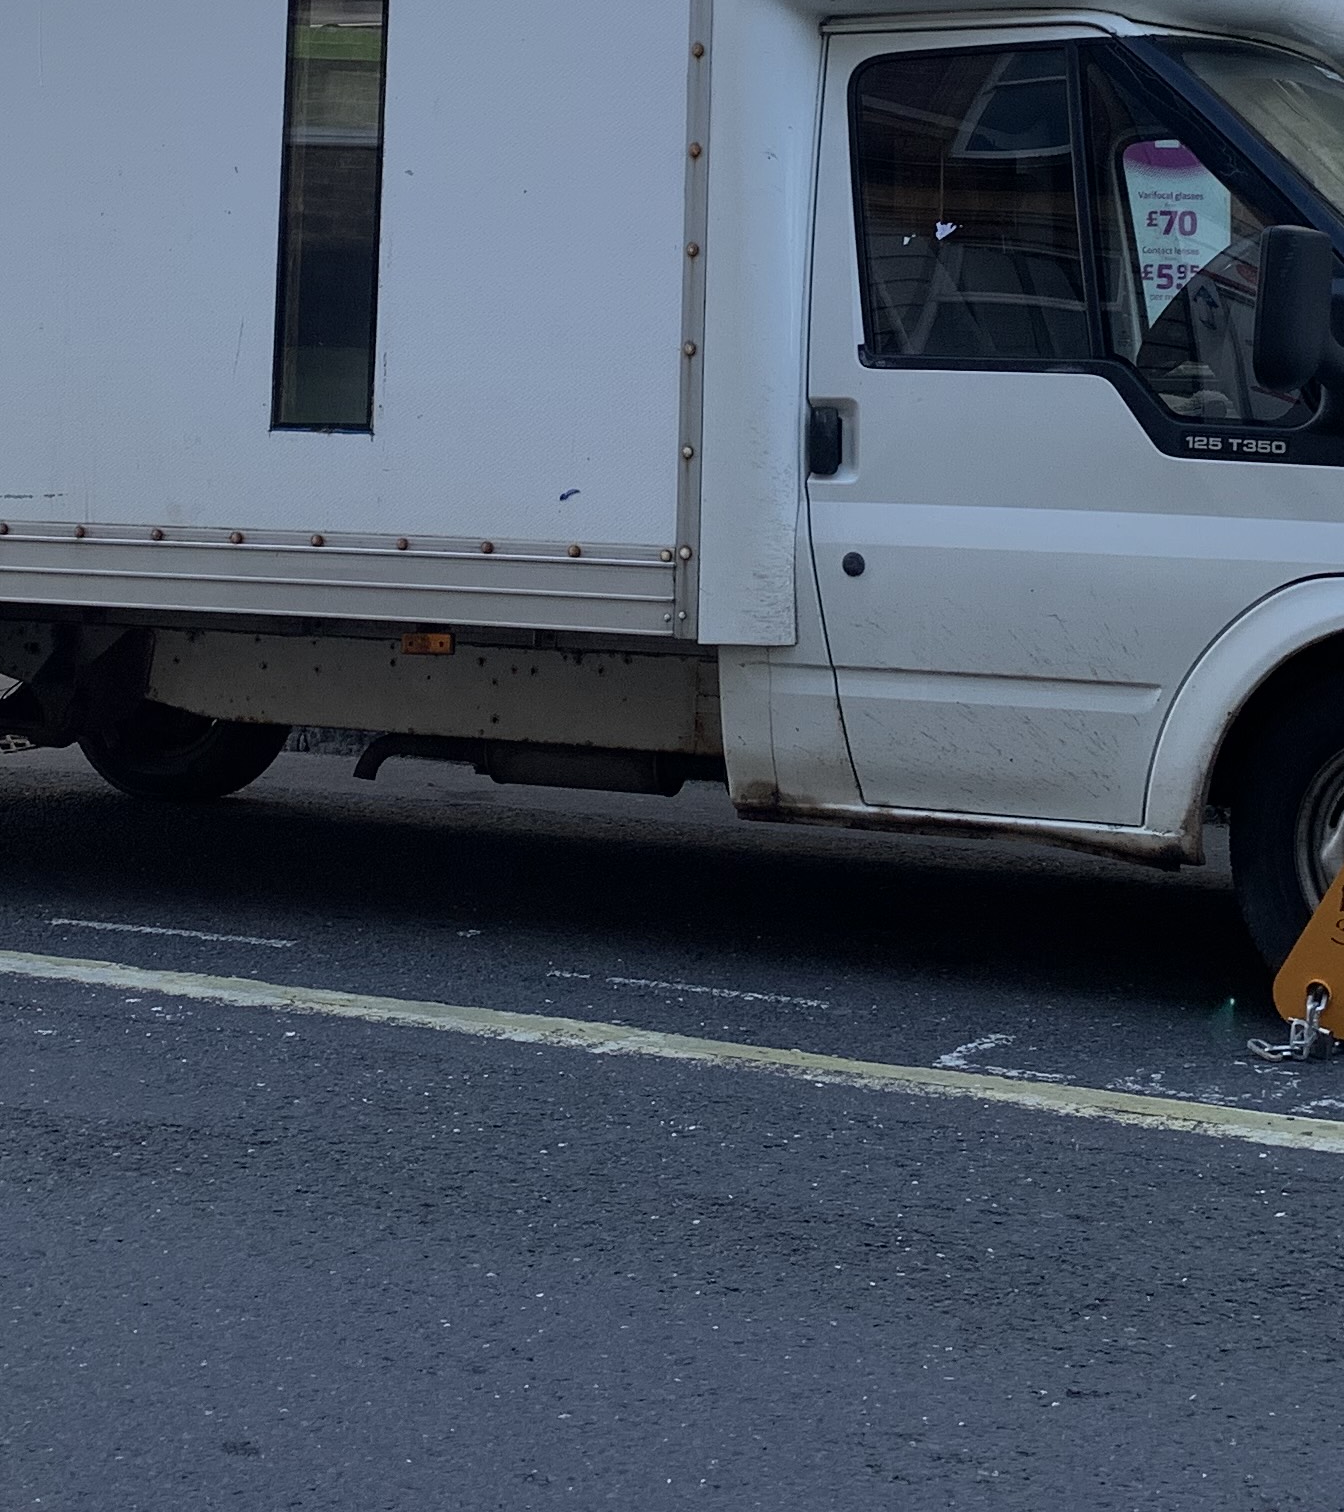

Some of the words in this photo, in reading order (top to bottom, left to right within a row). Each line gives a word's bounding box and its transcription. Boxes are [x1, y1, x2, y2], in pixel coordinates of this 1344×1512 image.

[1138, 191, 1174, 200] Varifocal
[1175, 192, 1204, 201] glasses
[1146, 210, 1198, 236] £70
[1142, 246, 1173, 255] Contact
[1185, 436, 1223, 450] 125
[1228, 438, 1286, 454] T350
